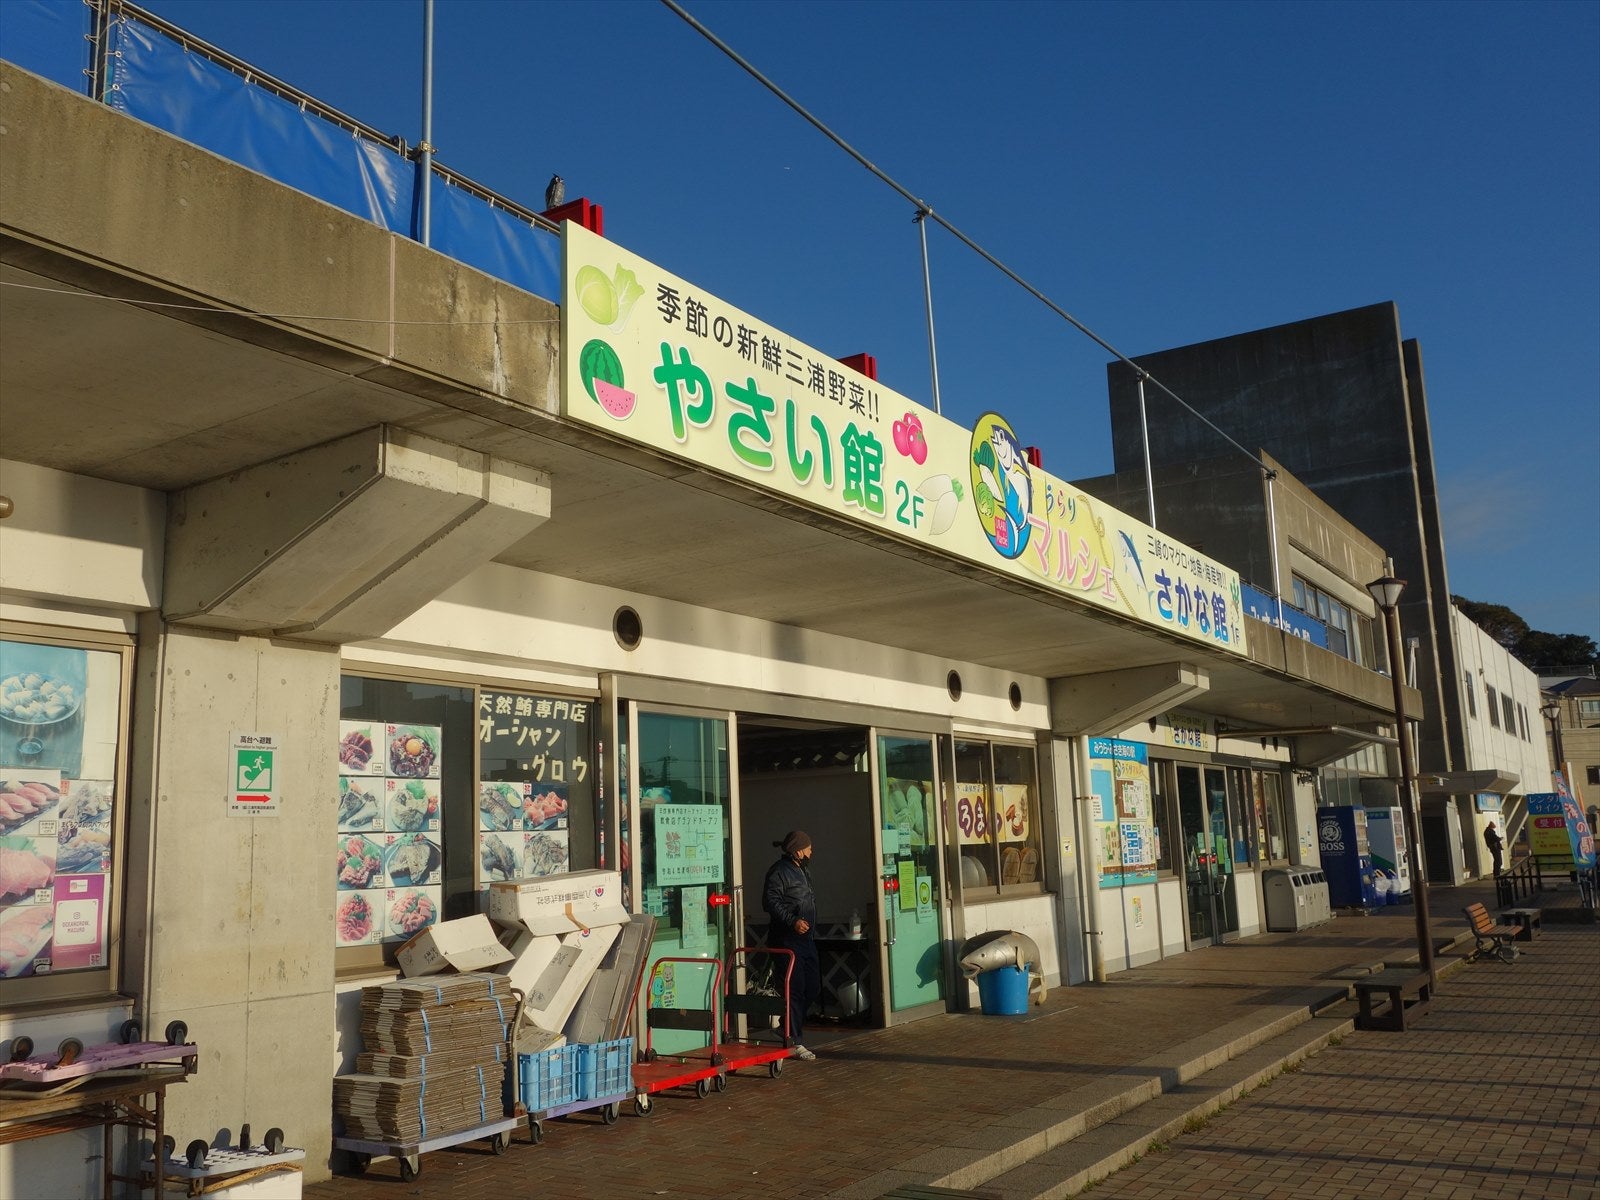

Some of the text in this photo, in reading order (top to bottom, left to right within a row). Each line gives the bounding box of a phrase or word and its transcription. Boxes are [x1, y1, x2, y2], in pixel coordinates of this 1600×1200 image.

[657, 283, 880, 423] 季節の新鮮三浦野菜!!
[653, 341, 886, 517] やさい館
[895, 479, 925, 529] 2F
[1027, 513, 1117, 602] マルシェ
[1154, 568, 1230, 644] さかな館
[480, 694, 587, 722] 天然鮪専門店
[480, 716, 561, 747] オーシャン
[1174, 725, 1201, 747] さかな館
[1320, 842, 1344, 851] BOSS
